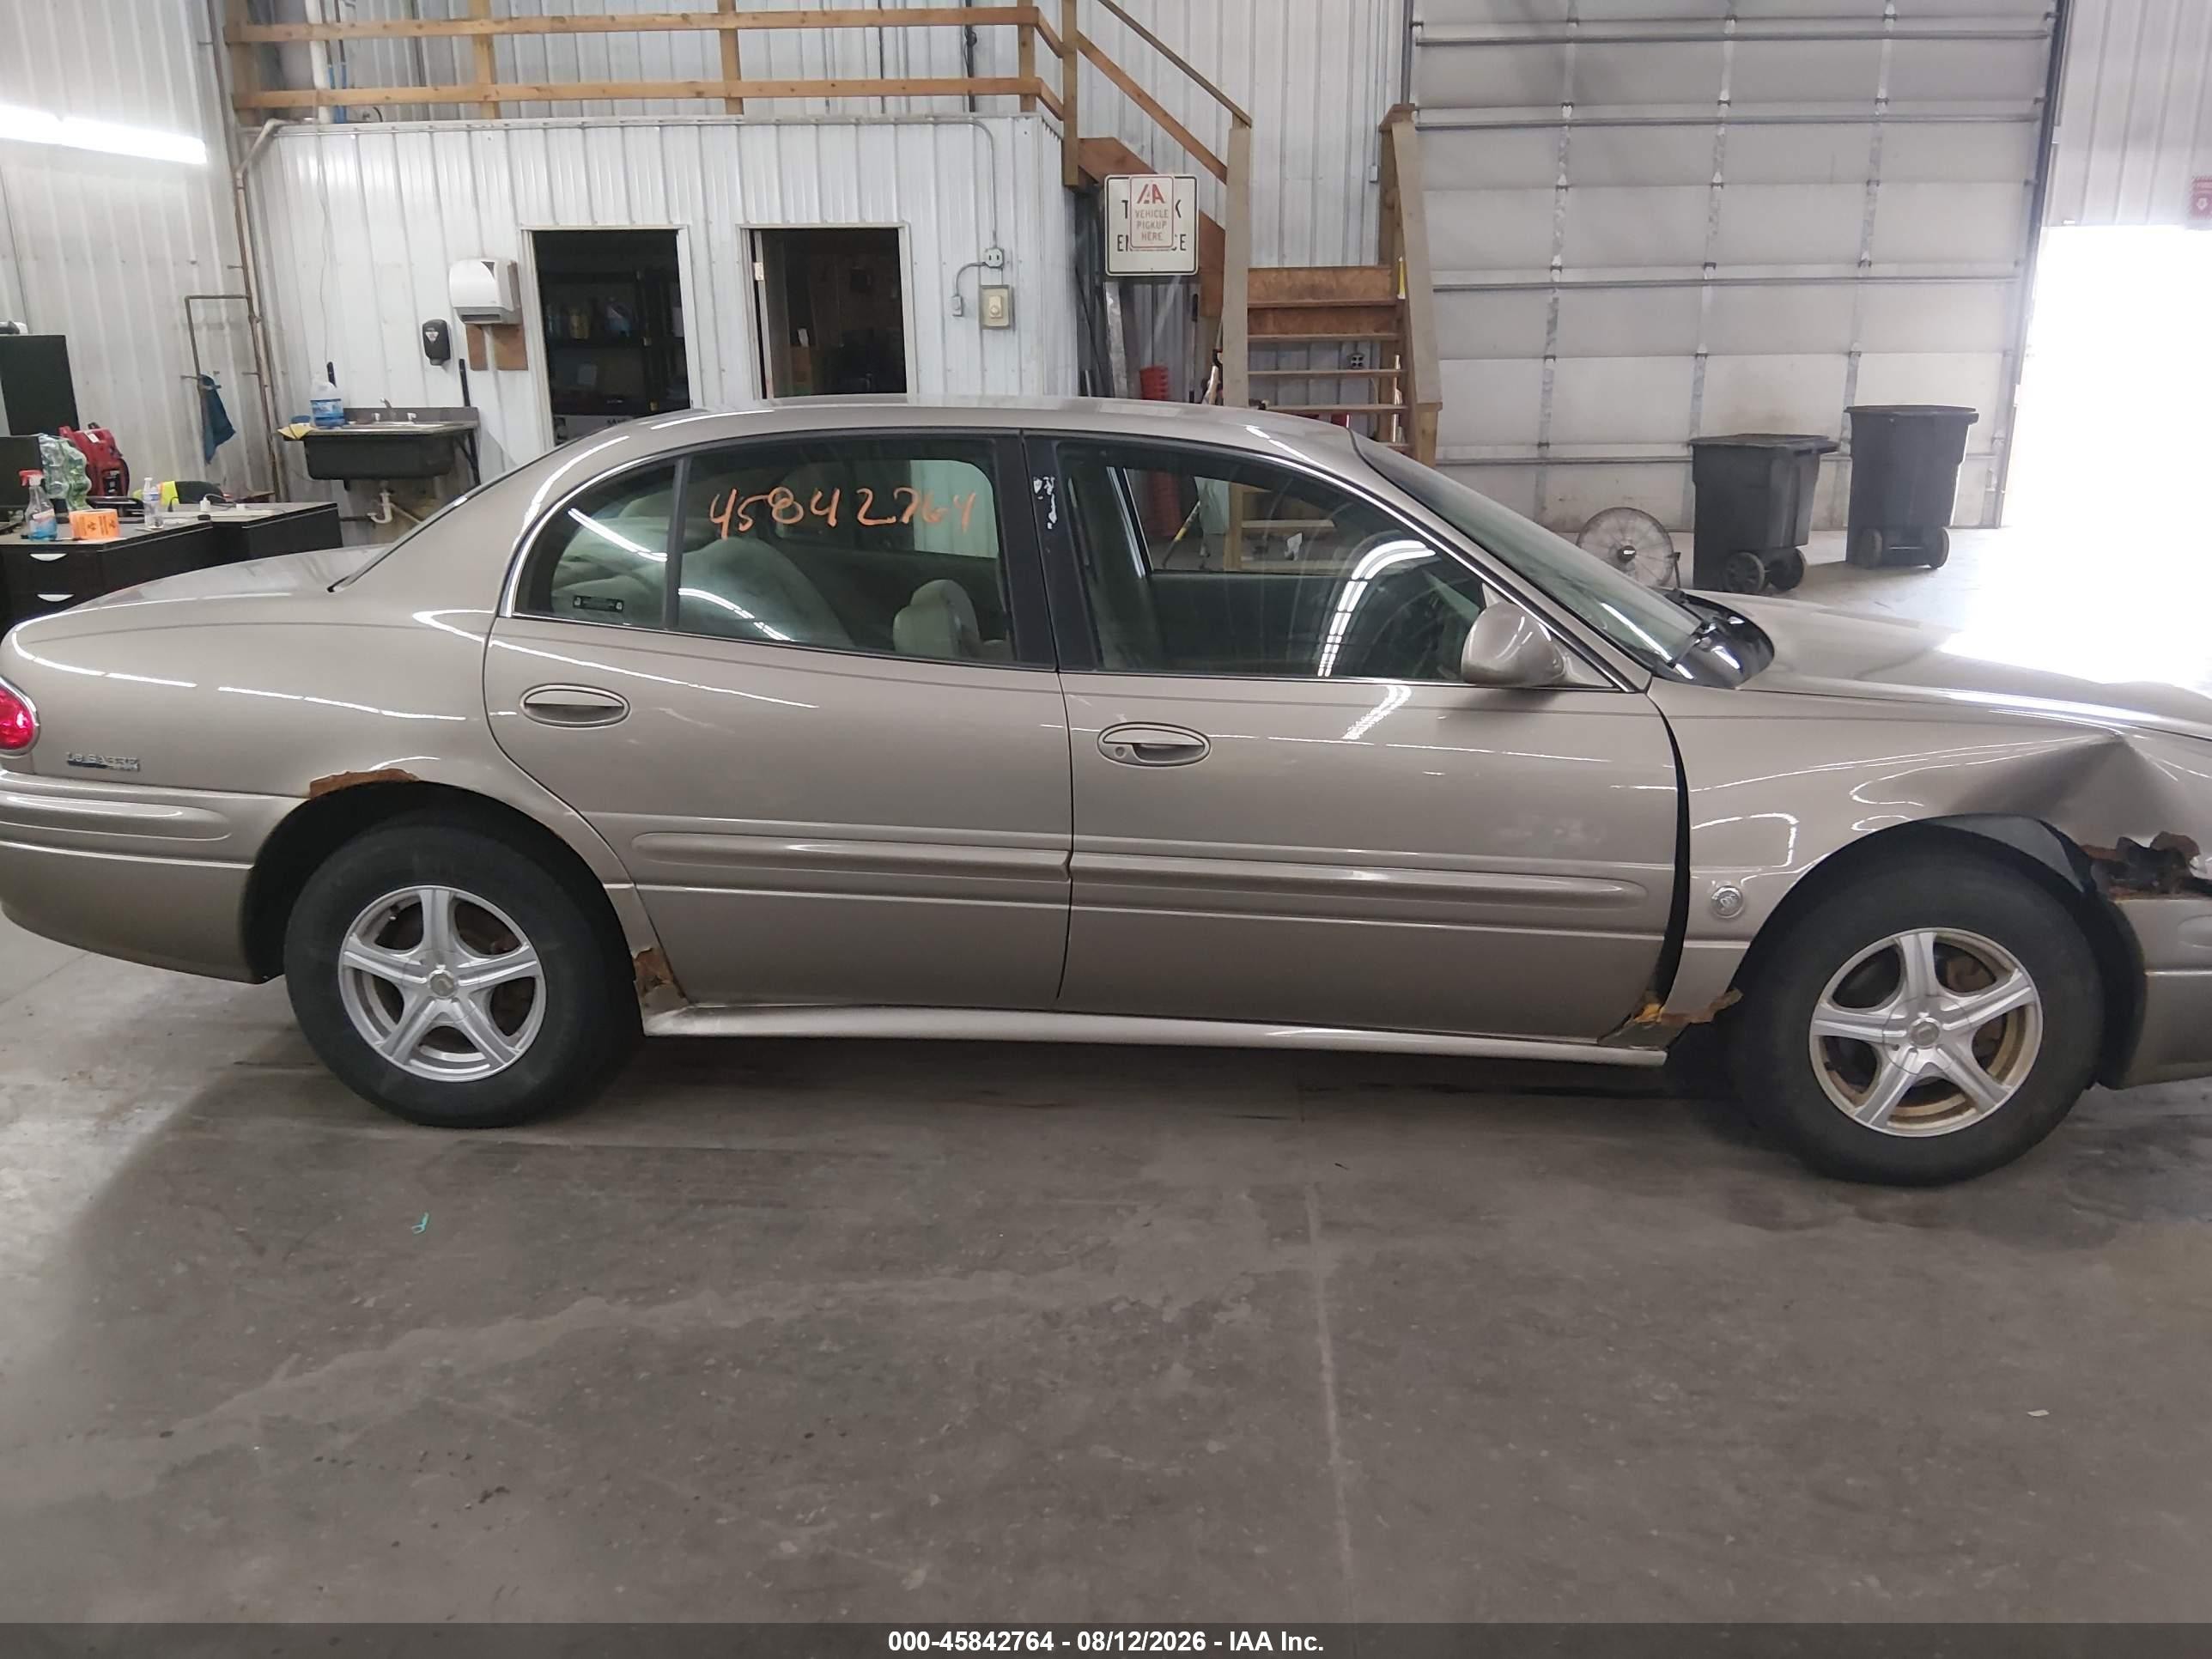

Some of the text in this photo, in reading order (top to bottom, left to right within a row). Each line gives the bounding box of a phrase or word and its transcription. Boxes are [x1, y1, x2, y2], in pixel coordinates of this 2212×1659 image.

[1134, 209, 1169, 219] VEHICLE
[1136, 220, 1168, 230] PICKUP
[1140, 231, 1164, 241] HERE
